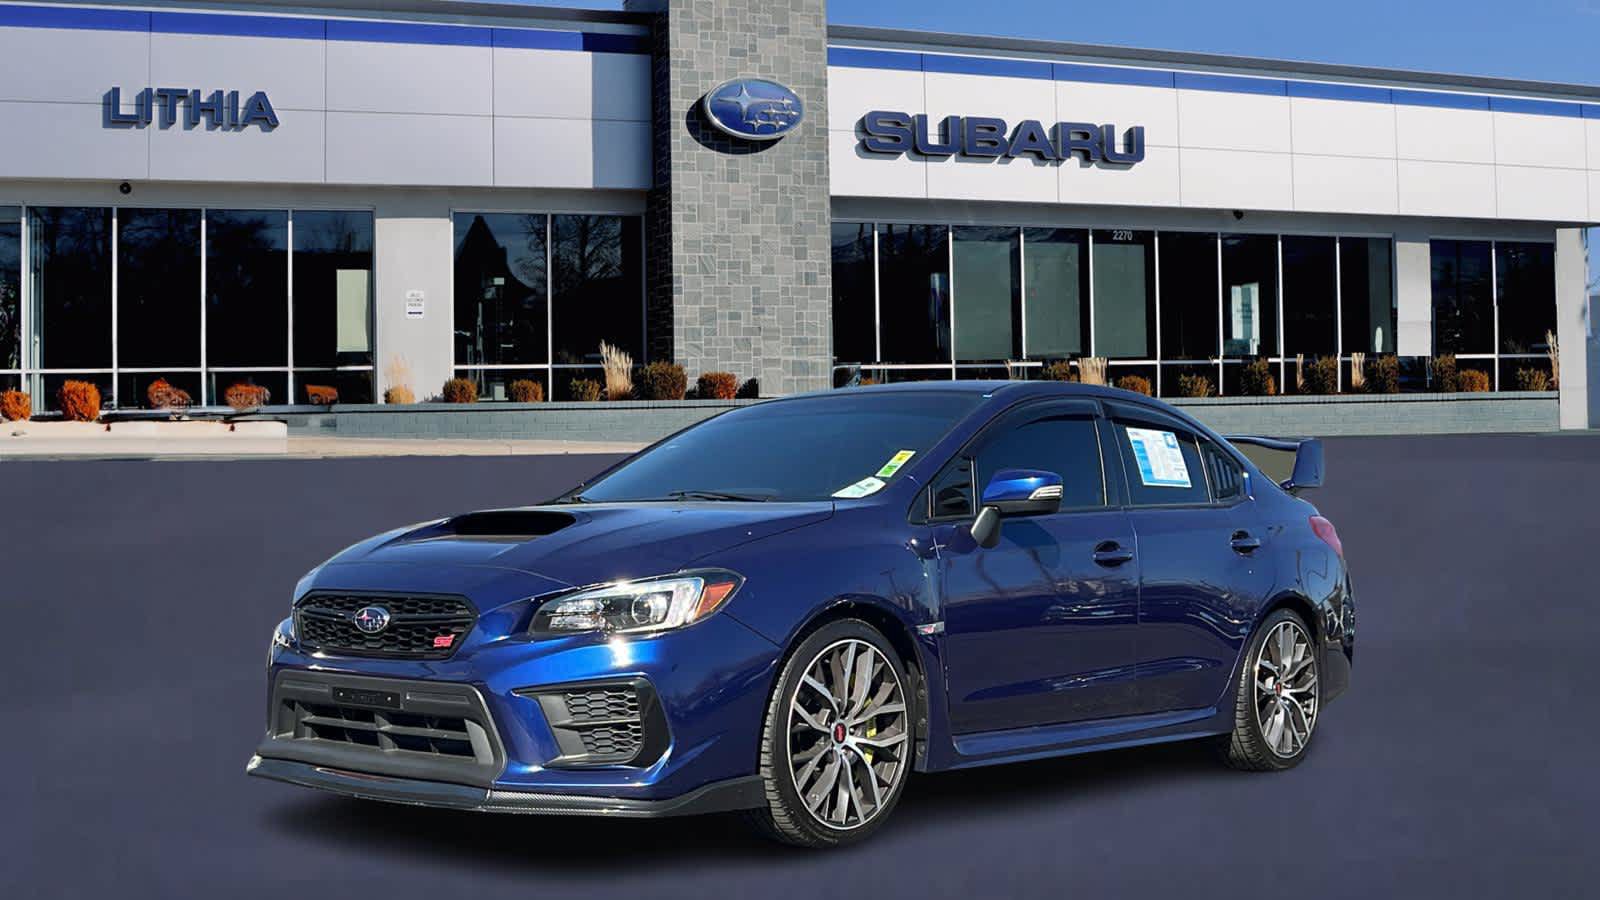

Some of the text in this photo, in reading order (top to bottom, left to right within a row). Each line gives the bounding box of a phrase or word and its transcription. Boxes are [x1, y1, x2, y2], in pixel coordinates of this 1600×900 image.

[104, 87, 280, 131] LITHIA
[858, 110, 1145, 168] SUBARU
[1112, 230, 1133, 241] 2270
